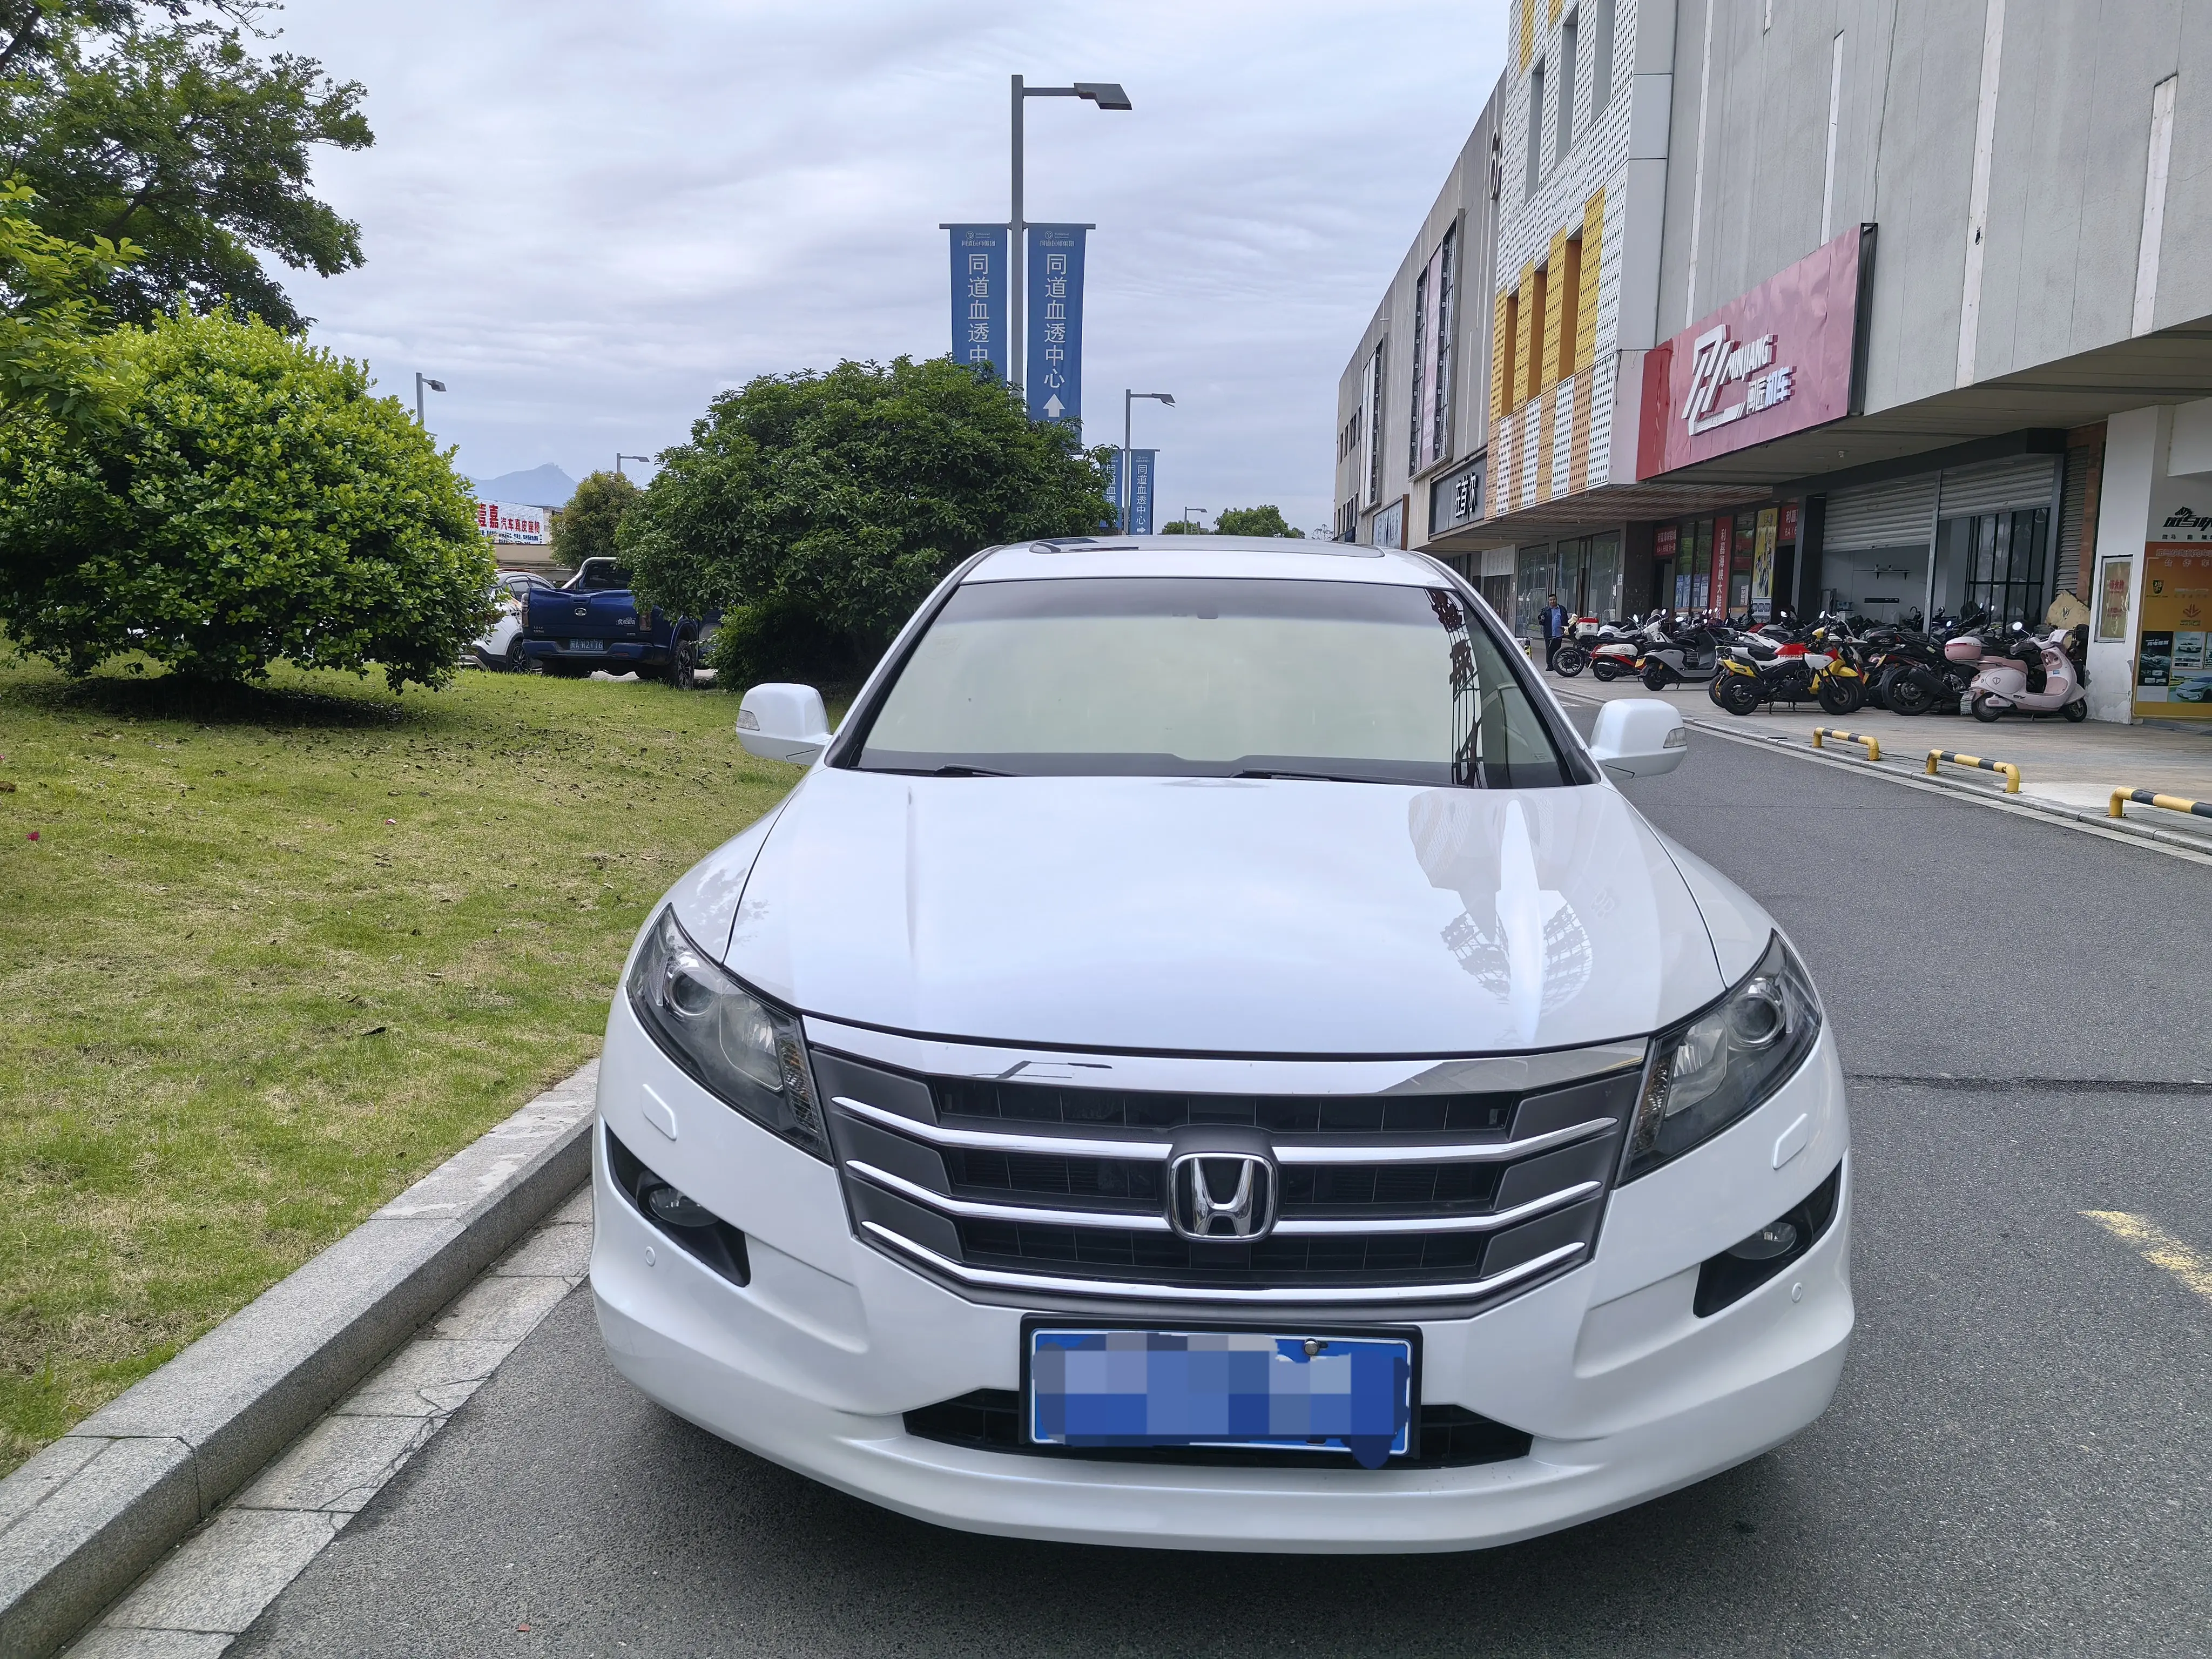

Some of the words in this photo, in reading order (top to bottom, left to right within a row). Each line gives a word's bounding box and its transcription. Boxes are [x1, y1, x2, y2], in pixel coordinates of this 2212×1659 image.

[1044, 254, 1067, 388] 同道血透中心
[1136, 464, 1148, 525] 同道血透中心
[501, 517, 540, 534] 汽车真皮座椅
